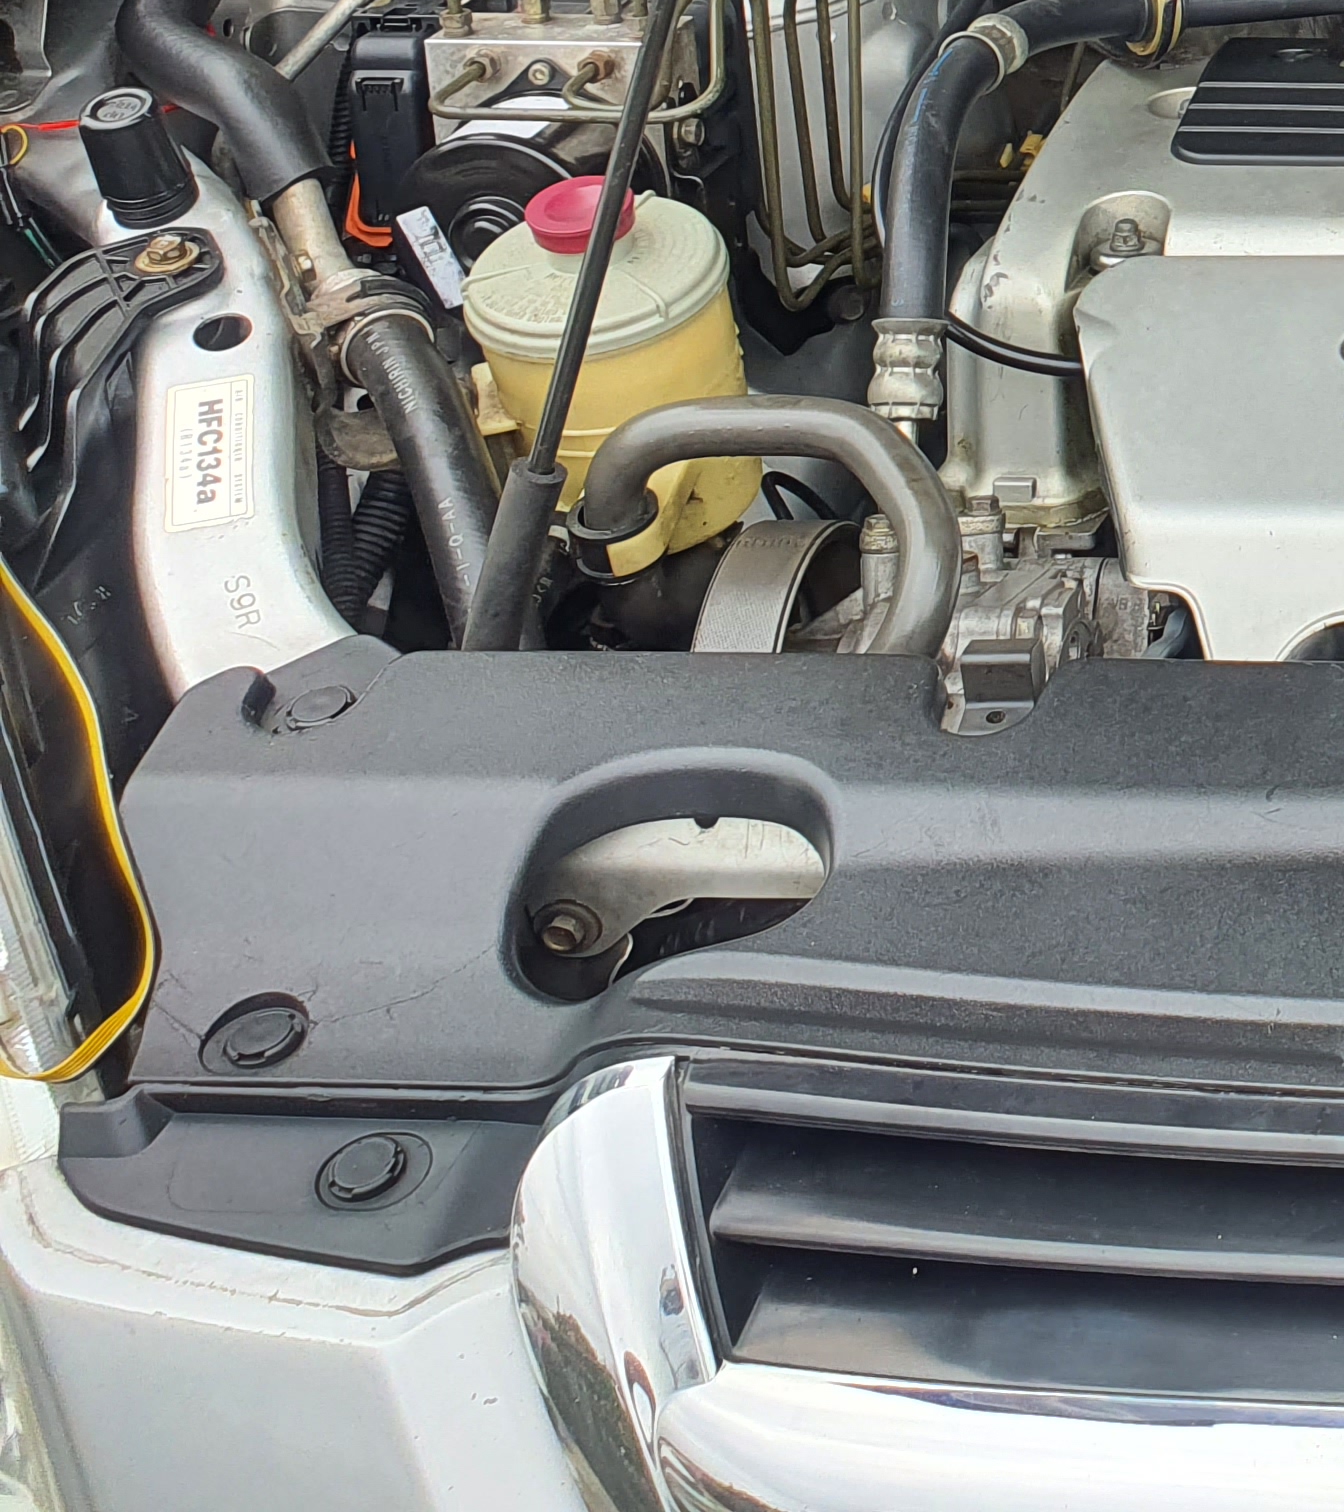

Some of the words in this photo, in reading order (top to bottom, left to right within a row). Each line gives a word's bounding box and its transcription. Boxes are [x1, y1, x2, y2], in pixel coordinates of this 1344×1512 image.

[381, 356, 418, 414] NICHIRIN
[196, 398, 224, 505] HFC134a
[224, 575, 261, 629] S9R
